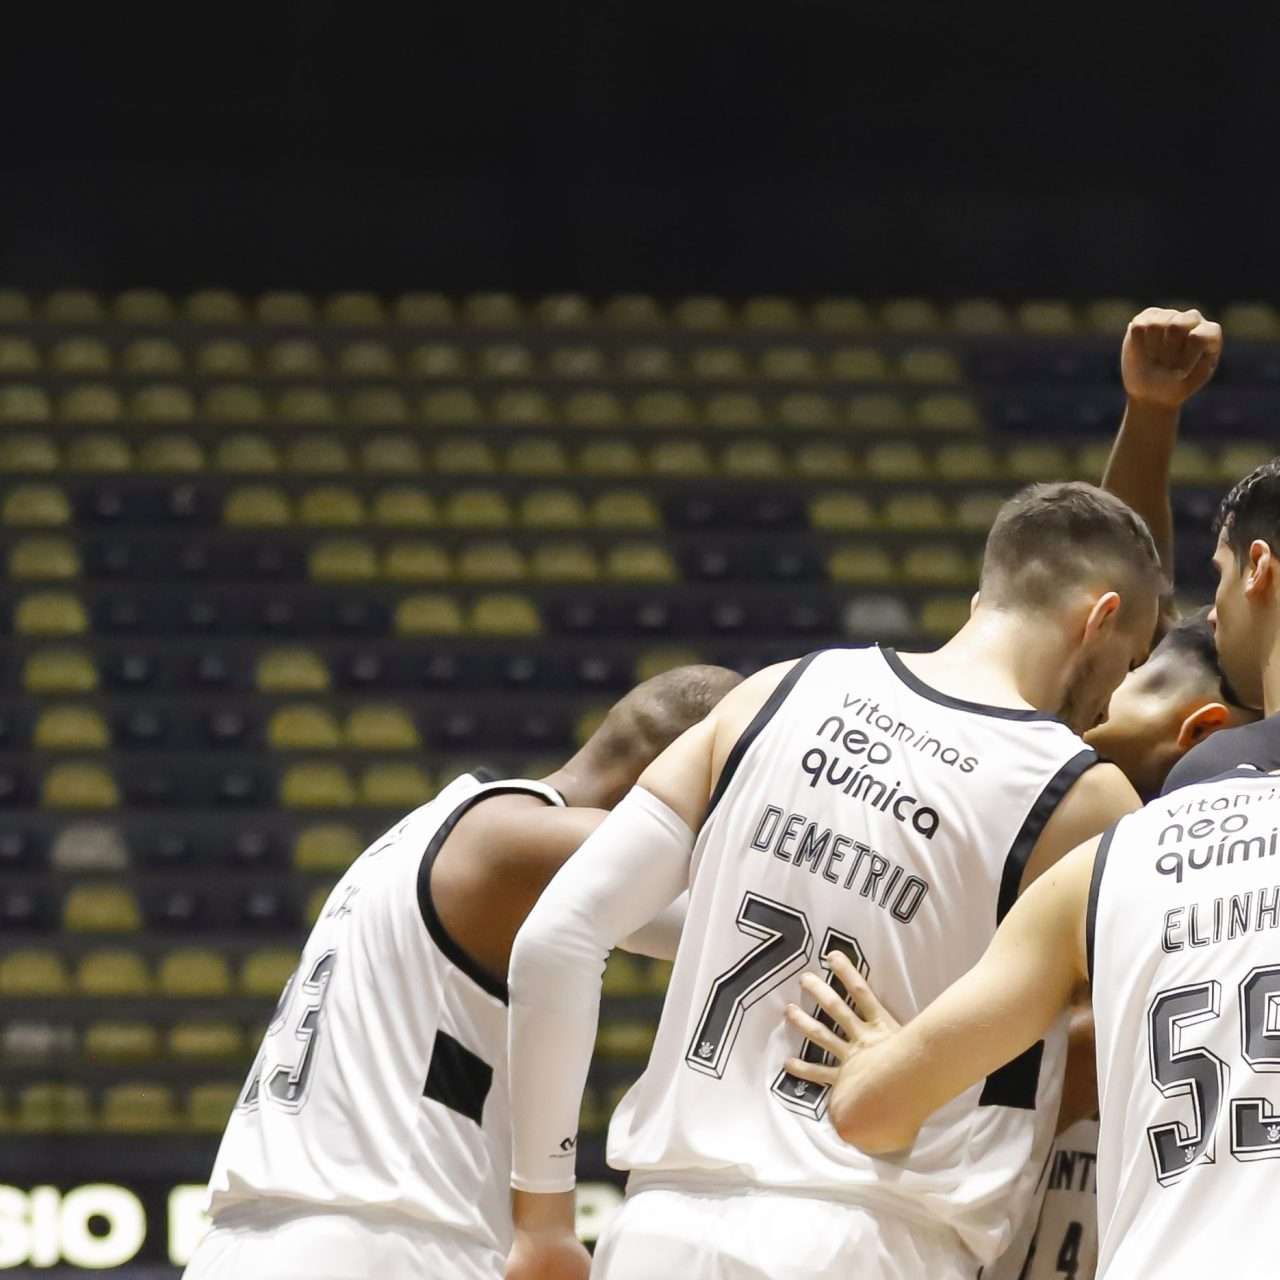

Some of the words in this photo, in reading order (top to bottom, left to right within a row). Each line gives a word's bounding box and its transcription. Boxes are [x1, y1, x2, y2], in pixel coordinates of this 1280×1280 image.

[815, 715, 892, 765] neo
[842, 692, 979, 773] vitaminas
[801, 747, 940, 840] química
[1157, 813, 1249, 846] neo
[749, 804, 930, 924] DEMETRIO
